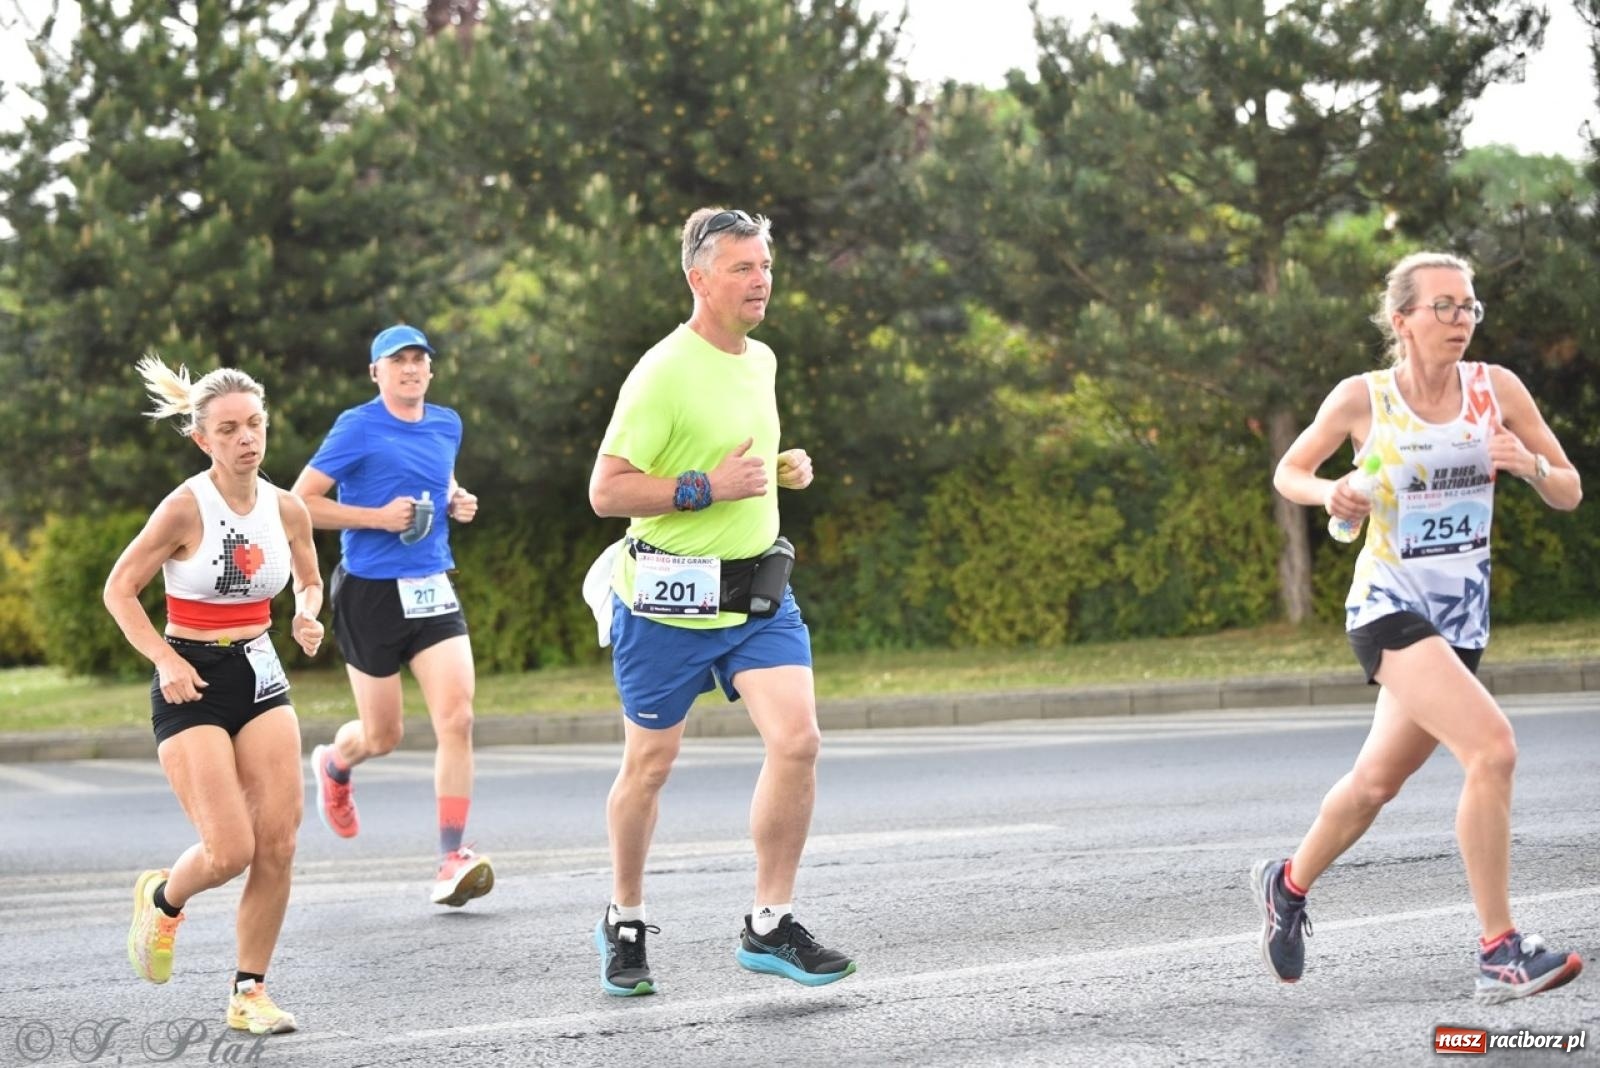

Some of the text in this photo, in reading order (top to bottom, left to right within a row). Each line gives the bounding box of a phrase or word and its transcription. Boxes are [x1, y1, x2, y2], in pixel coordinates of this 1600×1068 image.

[1451, 465, 1476, 478] BIEG
[1421, 514, 1472, 541] 254
[414, 588, 436, 604] 217
[654, 580, 696, 602] 201
